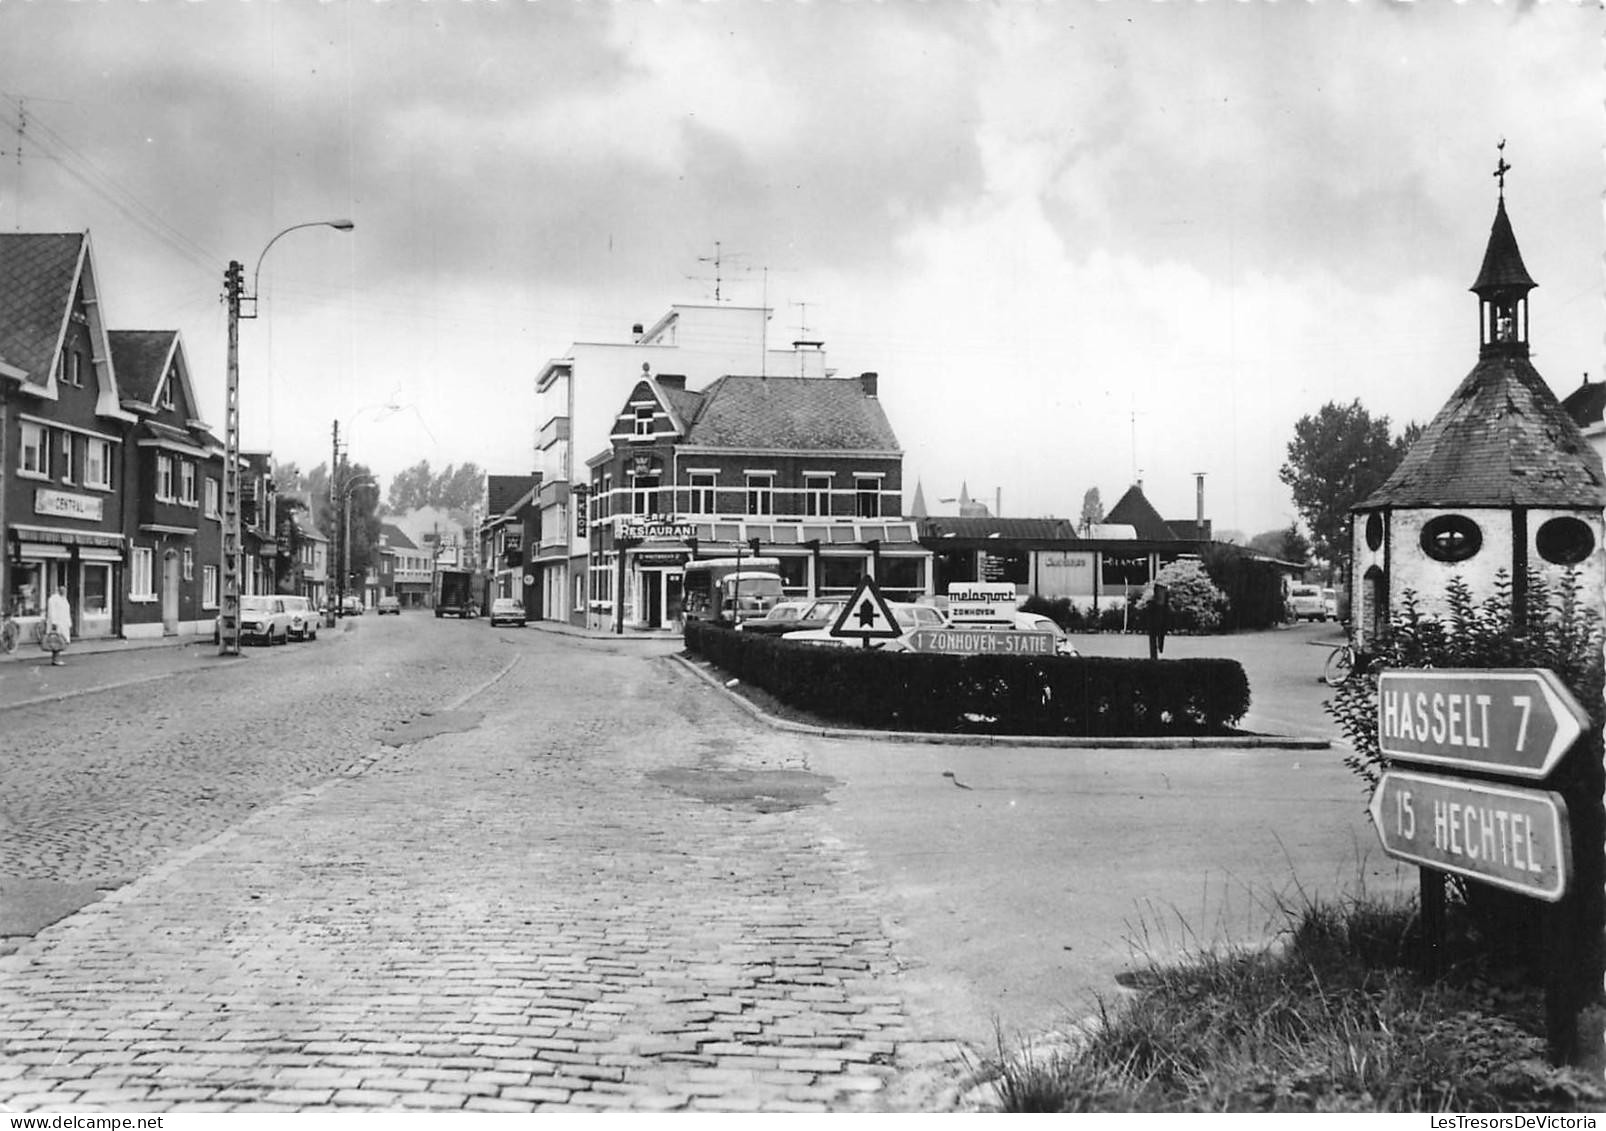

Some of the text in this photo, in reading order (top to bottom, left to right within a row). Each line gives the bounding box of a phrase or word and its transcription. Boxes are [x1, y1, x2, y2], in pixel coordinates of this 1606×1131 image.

[56, 497, 84, 513] CENTRAL
[620, 523, 697, 536] RESTAURANT
[953, 608, 995, 616] ZONHOVEN
[917, 633, 1047, 652] 1 ZONHOVEN-STATIE
[1384, 690, 1531, 752] HASSELT 7
[1396, 789, 1542, 873] 15 HECHTEL
